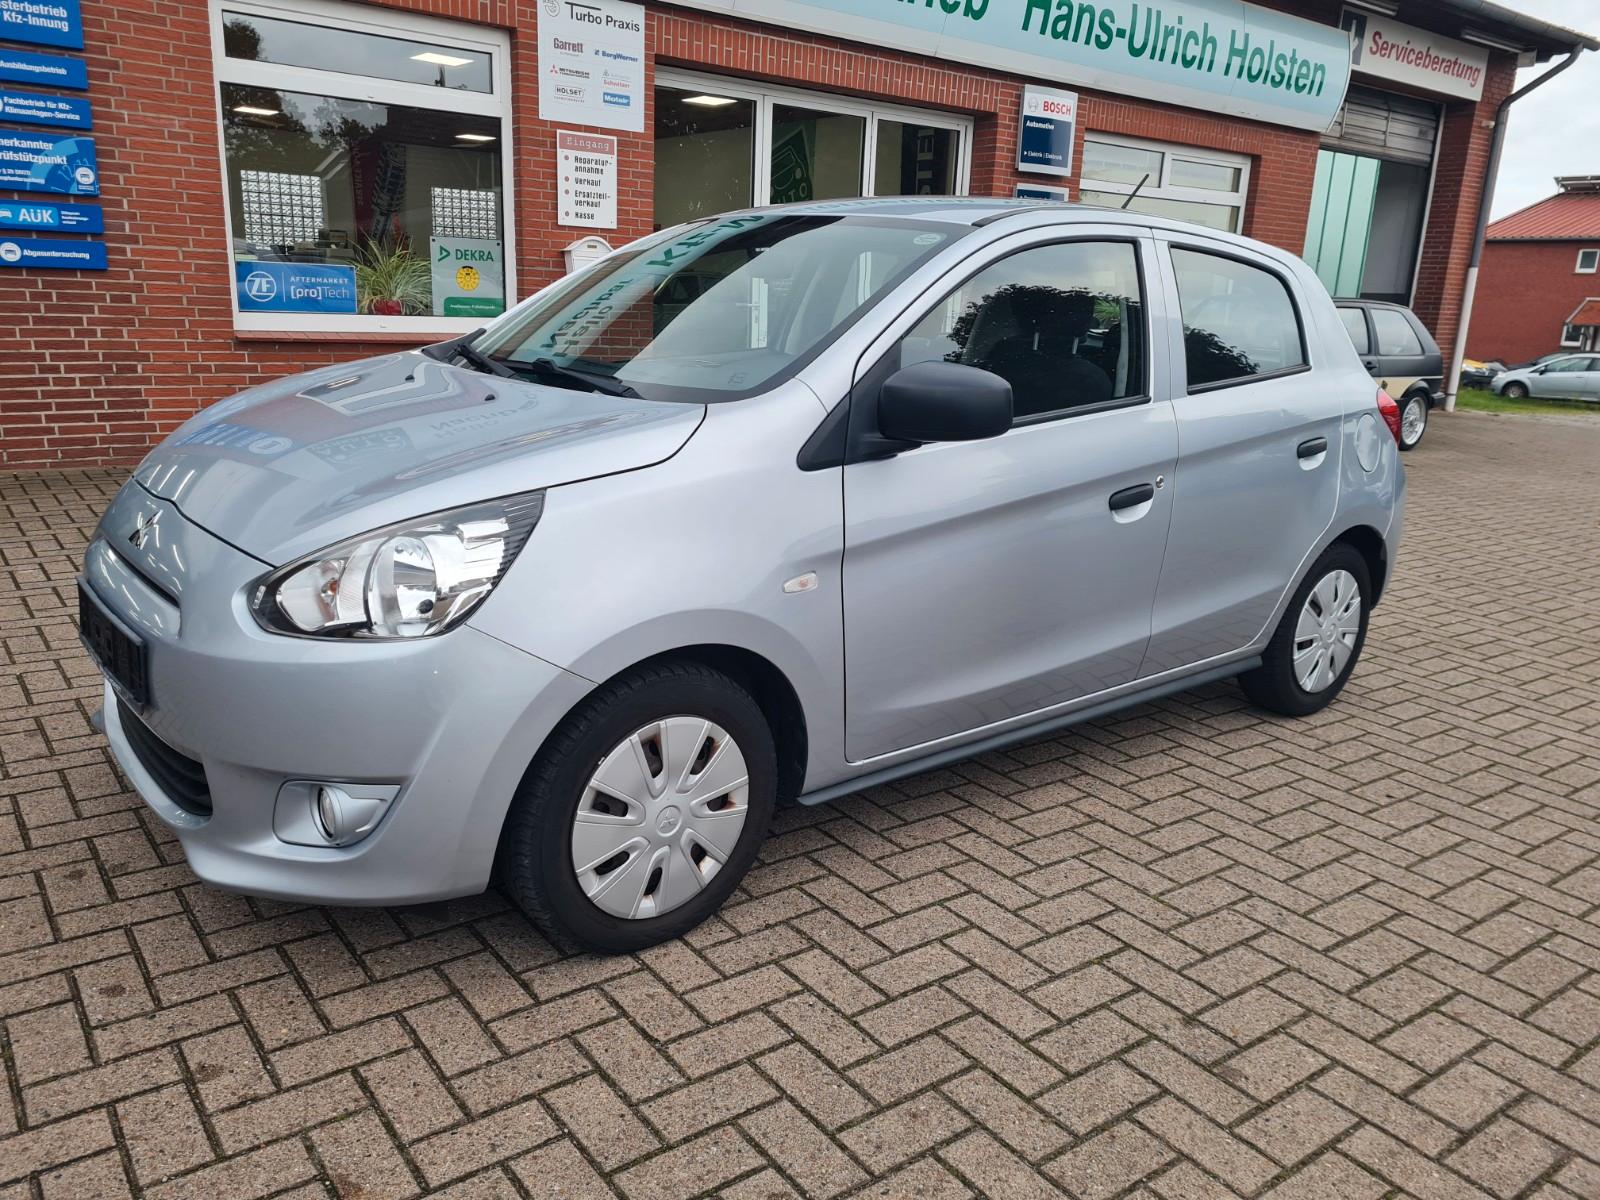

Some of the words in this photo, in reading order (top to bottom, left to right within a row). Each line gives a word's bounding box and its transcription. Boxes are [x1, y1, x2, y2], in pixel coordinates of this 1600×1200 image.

[3, 10, 69, 32] Kfz-Innung
[564, 1, 602, 25] Turbo
[606, 15, 640, 32] Praxis
[553, 37, 584, 53] Garrett
[1021, 0, 1217, 73] Hans-Ulrich
[1223, 29, 1326, 97] Holsten
[1369, 30, 1481, 88] Serviceberatung
[556, 87, 582, 96] HOLSET
[1043, 100, 1071, 116] BOSCH
[1026, 119, 1055, 131] Automotive
[566, 136, 609, 152] Eingang
[574, 155, 612, 166] Reparatur-
[574, 165, 604, 175] annahme
[574, 189, 611, 200] Ersatzteil-
[18, 203, 55, 223] AÜK
[574, 211, 596, 220] Kasse
[23, 248, 90, 260] Abgasuntersuchung
[455, 248, 495, 262] DEKRA
[289, 275, 349, 285] AFTERMARKET
[290, 285, 351, 300] [pro]Tech
